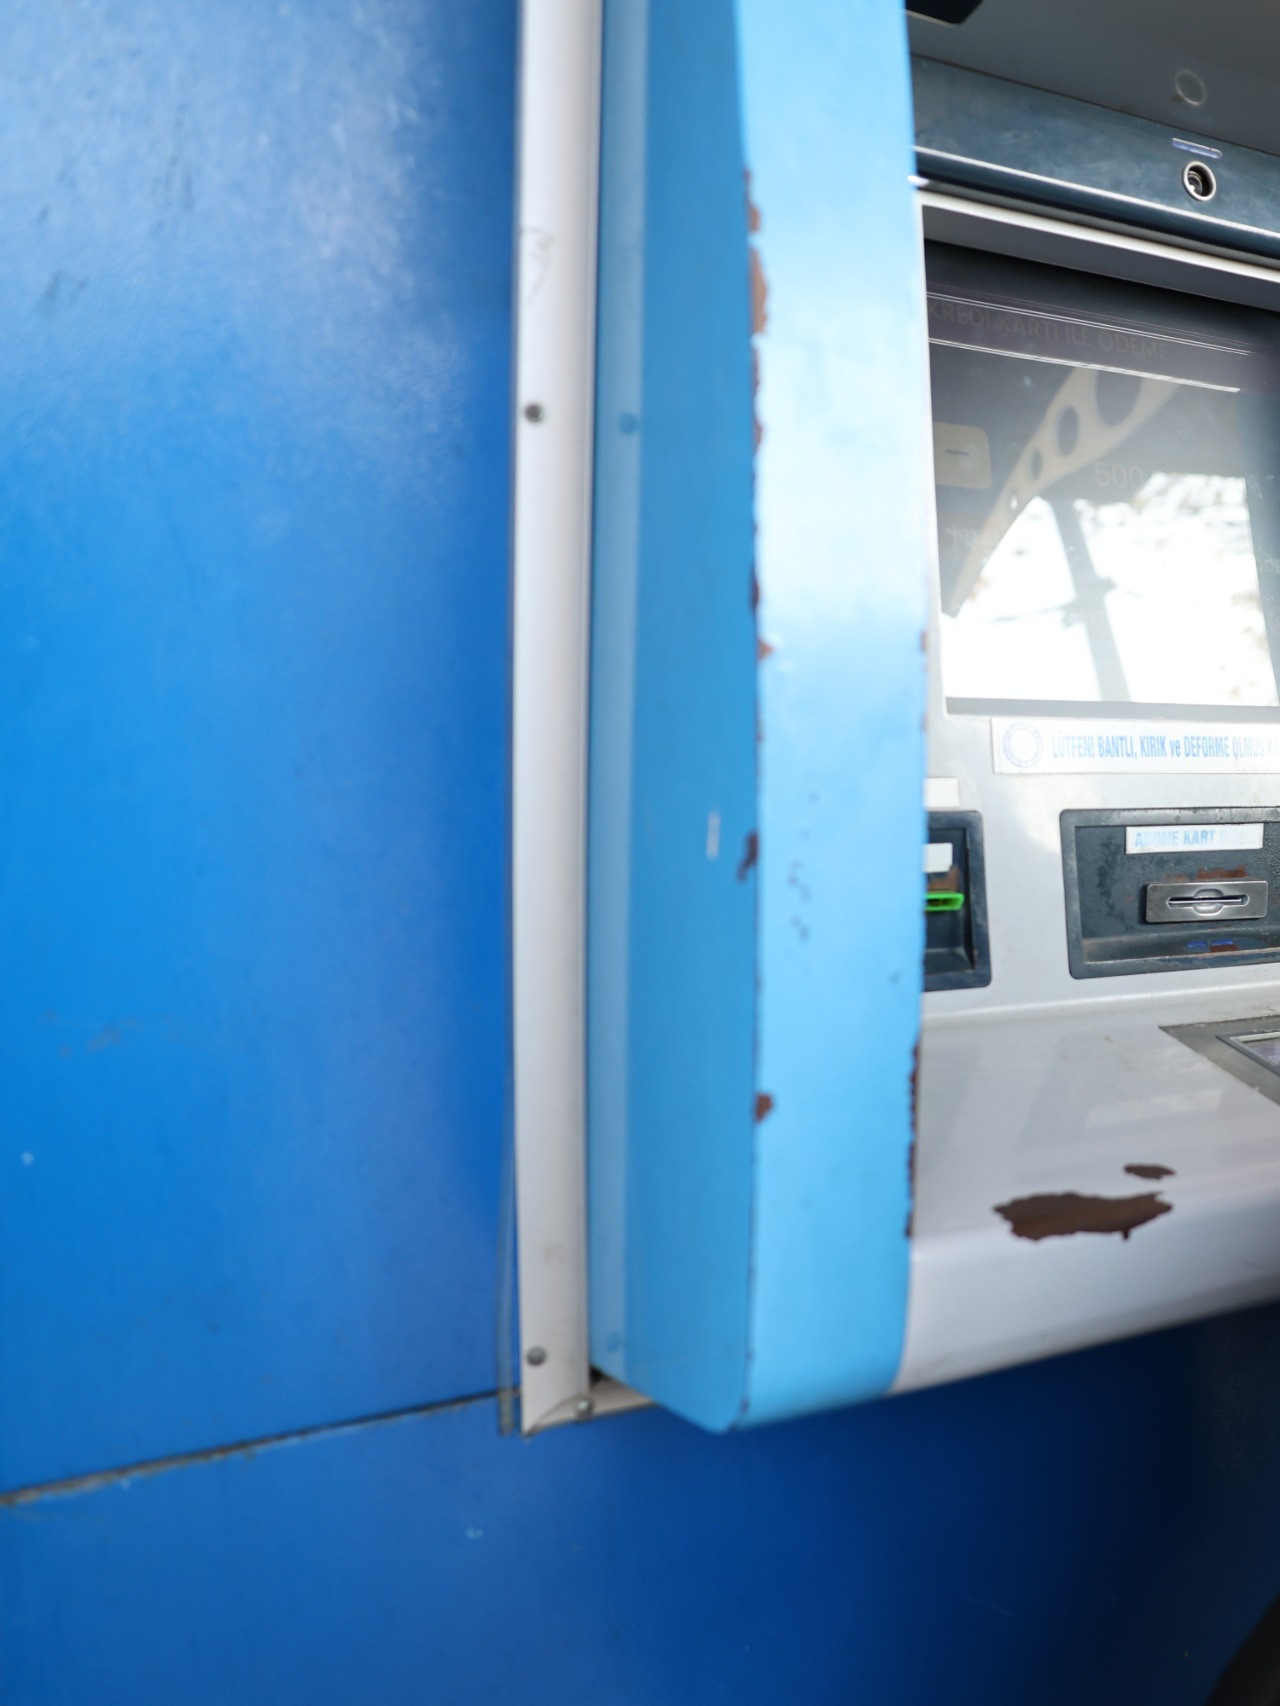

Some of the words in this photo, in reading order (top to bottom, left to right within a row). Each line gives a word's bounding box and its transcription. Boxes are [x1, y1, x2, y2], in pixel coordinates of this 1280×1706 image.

[1139, 735, 1167, 758] KIRIK
[1169, 739, 1181, 758] ve
[1183, 736, 1230, 758] DEFORME
[1183, 830, 1216, 845] KART
